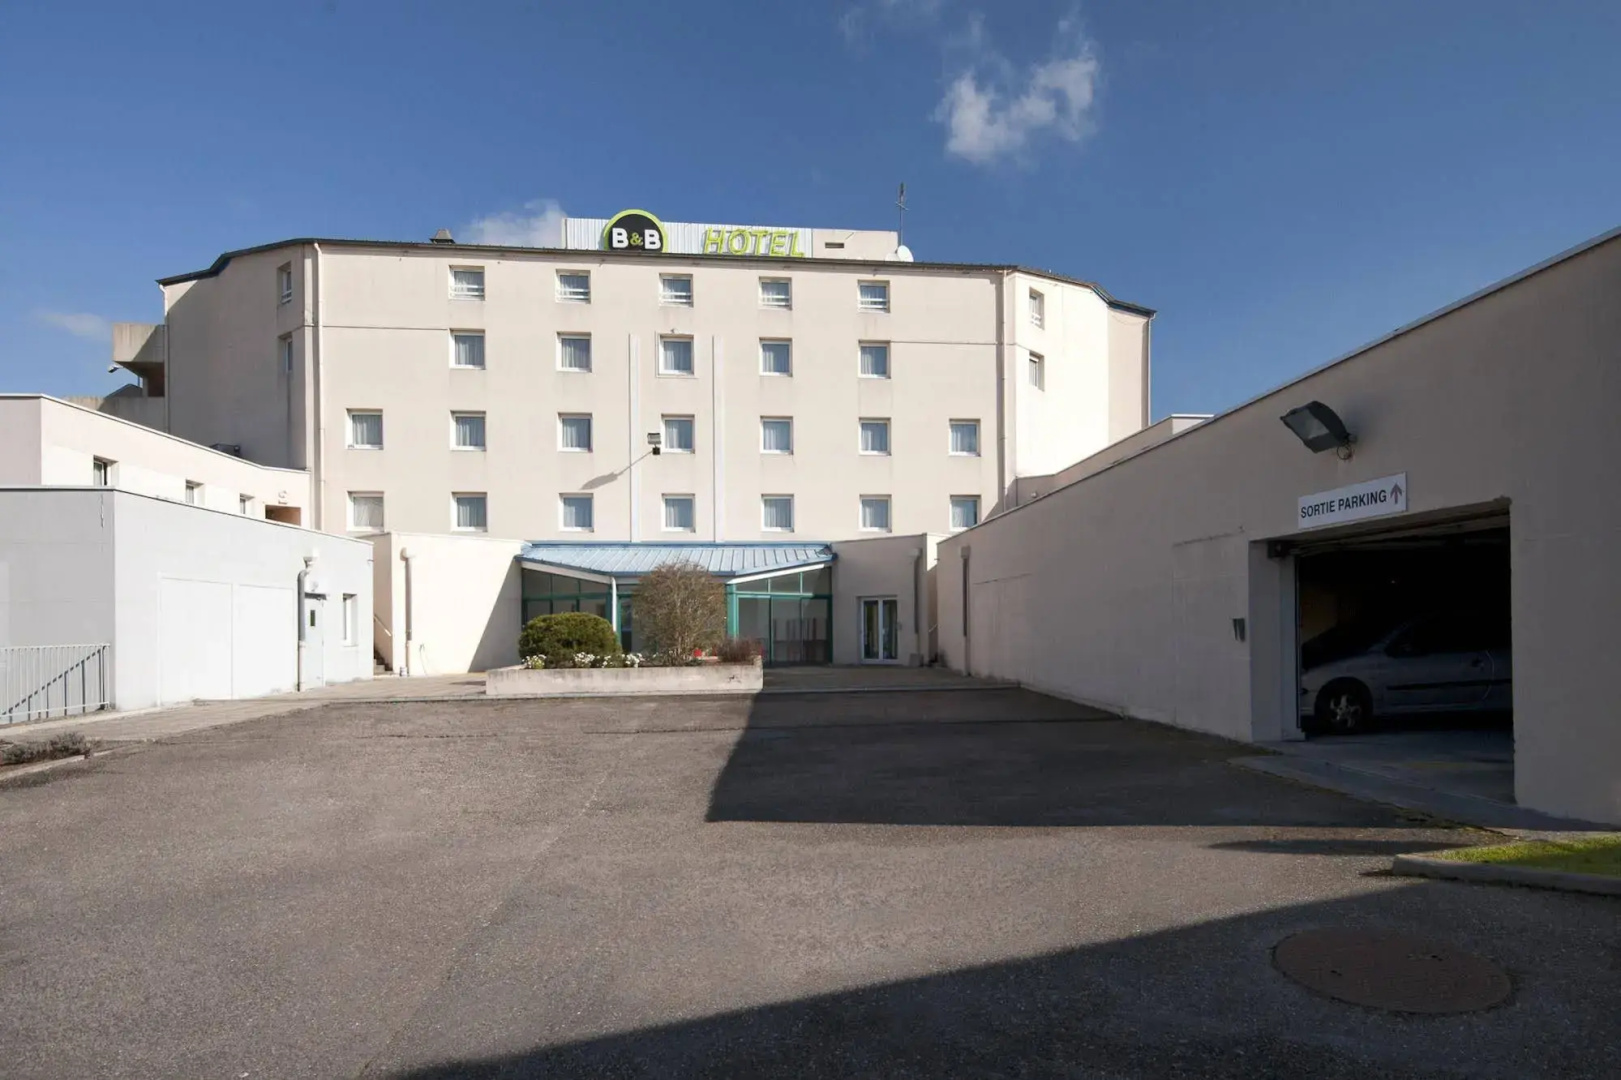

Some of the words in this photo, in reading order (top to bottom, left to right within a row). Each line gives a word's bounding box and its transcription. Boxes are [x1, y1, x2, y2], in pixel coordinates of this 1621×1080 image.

[612, 228, 662, 249] B&B
[704, 227, 805, 257] HOTEL
[1301, 500, 1335, 518] SORTIE
[1338, 490, 1387, 511] PARKING
